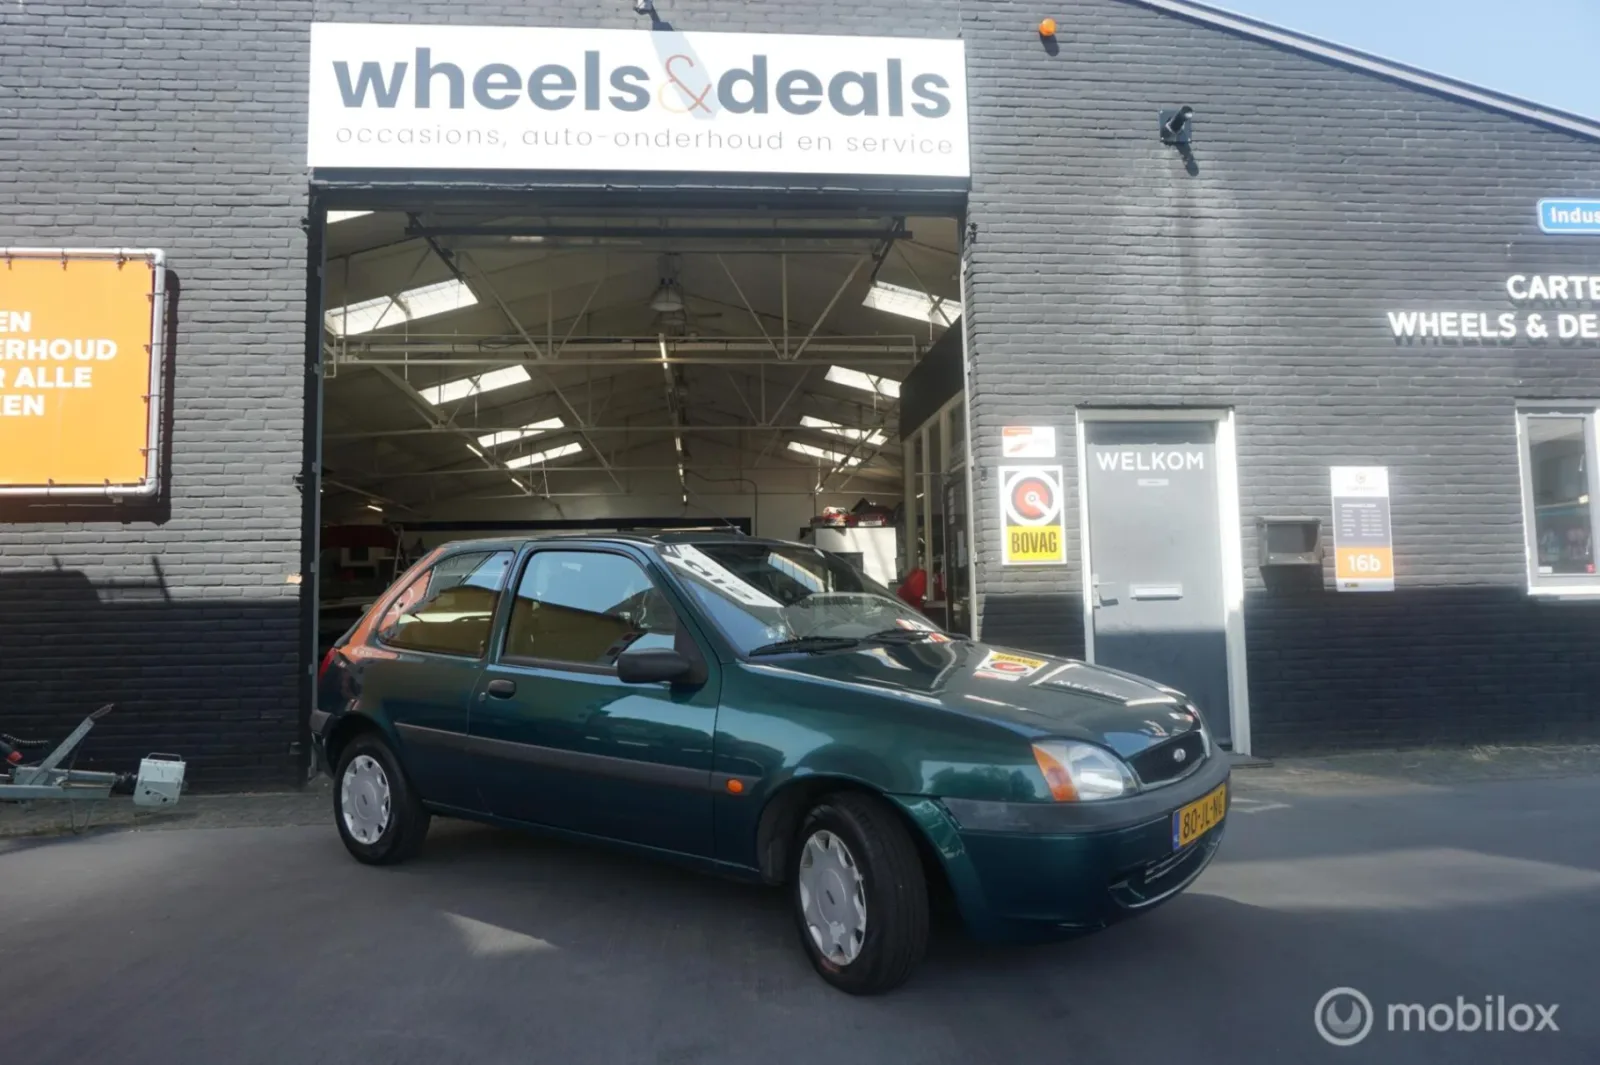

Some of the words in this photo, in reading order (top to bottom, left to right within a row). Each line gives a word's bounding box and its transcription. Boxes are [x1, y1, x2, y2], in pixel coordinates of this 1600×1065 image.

[336, 125, 507, 148] occasions,
[522, 127, 783, 149] auto-onderhoud
[797, 135, 832, 151] en
[847, 133, 953, 154] service
[1387, 311, 1517, 338] WHEELS
[1525, 313, 1549, 338] &
[1557, 313, 1599, 339] DE
[0, 338, 118, 362] RHOUD
[14, 366, 93, 389] ALLE
[0, 394, 45, 417] EN
[1096, 451, 1205, 472] WELKOM
[1011, 531, 1058, 554] BOVAG
[1347, 554, 1381, 572] 16b
